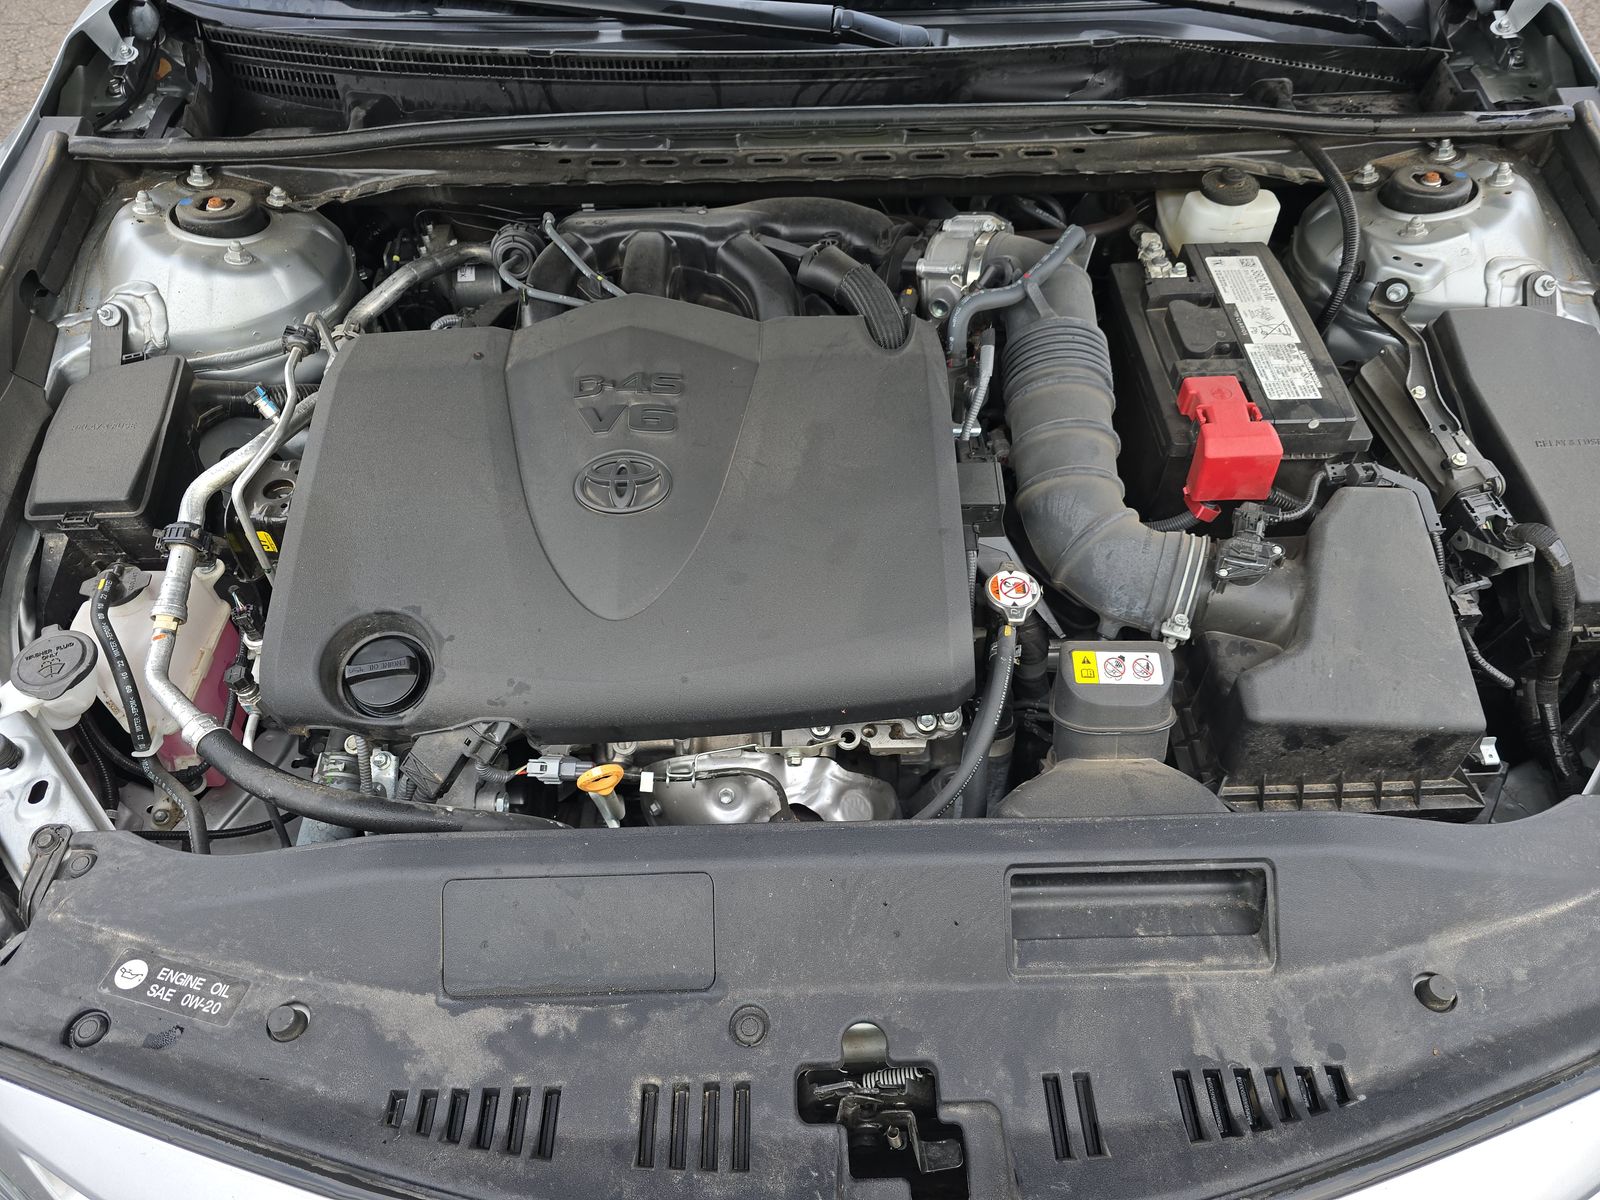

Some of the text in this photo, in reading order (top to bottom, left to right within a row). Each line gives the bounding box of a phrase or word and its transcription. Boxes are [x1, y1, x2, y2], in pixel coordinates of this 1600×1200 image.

[577, 404, 678, 434] V6
[25, 641, 74, 661] WASHER FLUID
[41, 652, 59, 661] ONLY
[157, 967, 230, 999] ENGINE OIL
[147, 984, 222, 1015] SAE 0W-20
